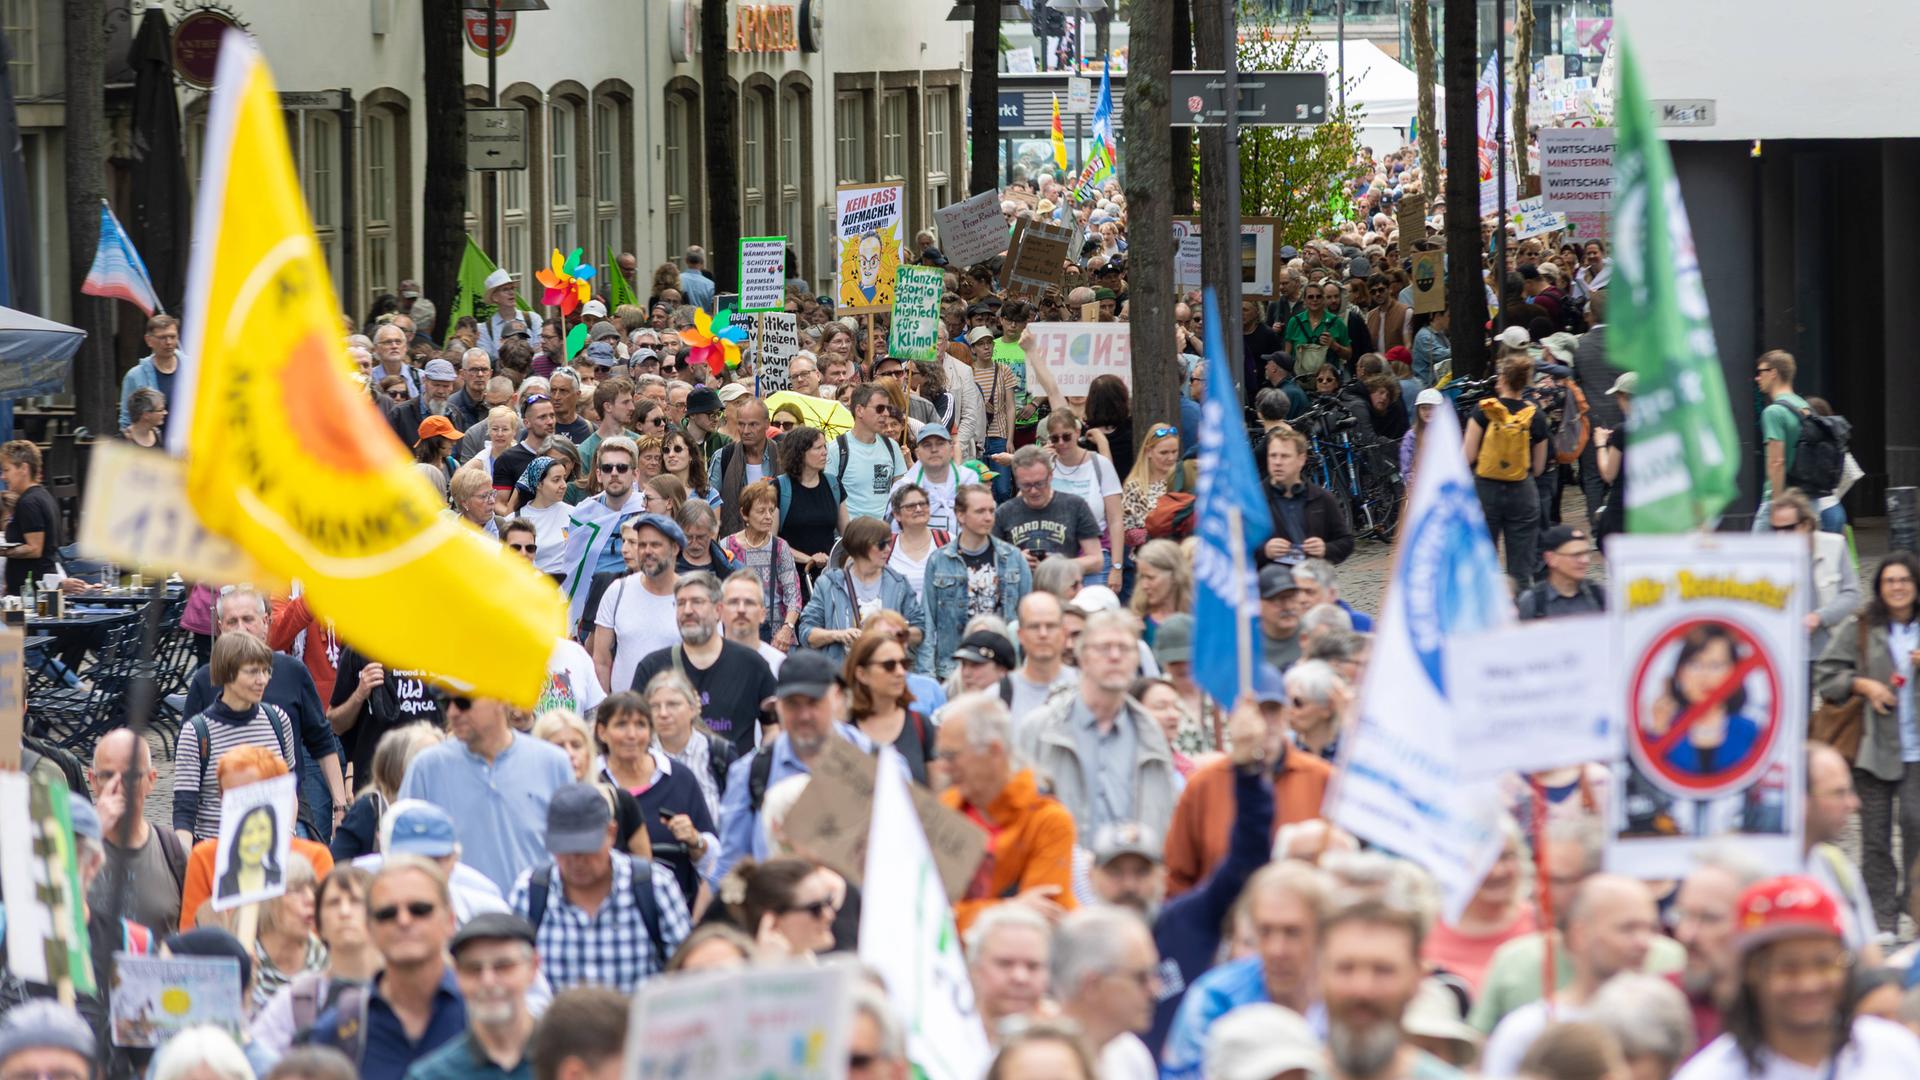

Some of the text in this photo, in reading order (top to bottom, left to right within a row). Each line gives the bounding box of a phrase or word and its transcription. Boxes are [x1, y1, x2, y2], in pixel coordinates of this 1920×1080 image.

[845, 187, 897, 213] KEIN FASS
[842, 202, 897, 227] AUFMACHEN,
[844, 224, 860, 236] HERR
[897, 267, 942, 287] Pflanzen
[895, 293, 923, 305] Jahre
[748, 315, 795, 332] Poitiker
[896, 318, 920, 332] fürs
[750, 332, 796, 346] vrheizen
[765, 366, 784, 377] der
[1011, 520, 1067, 542] HARD ROCK
